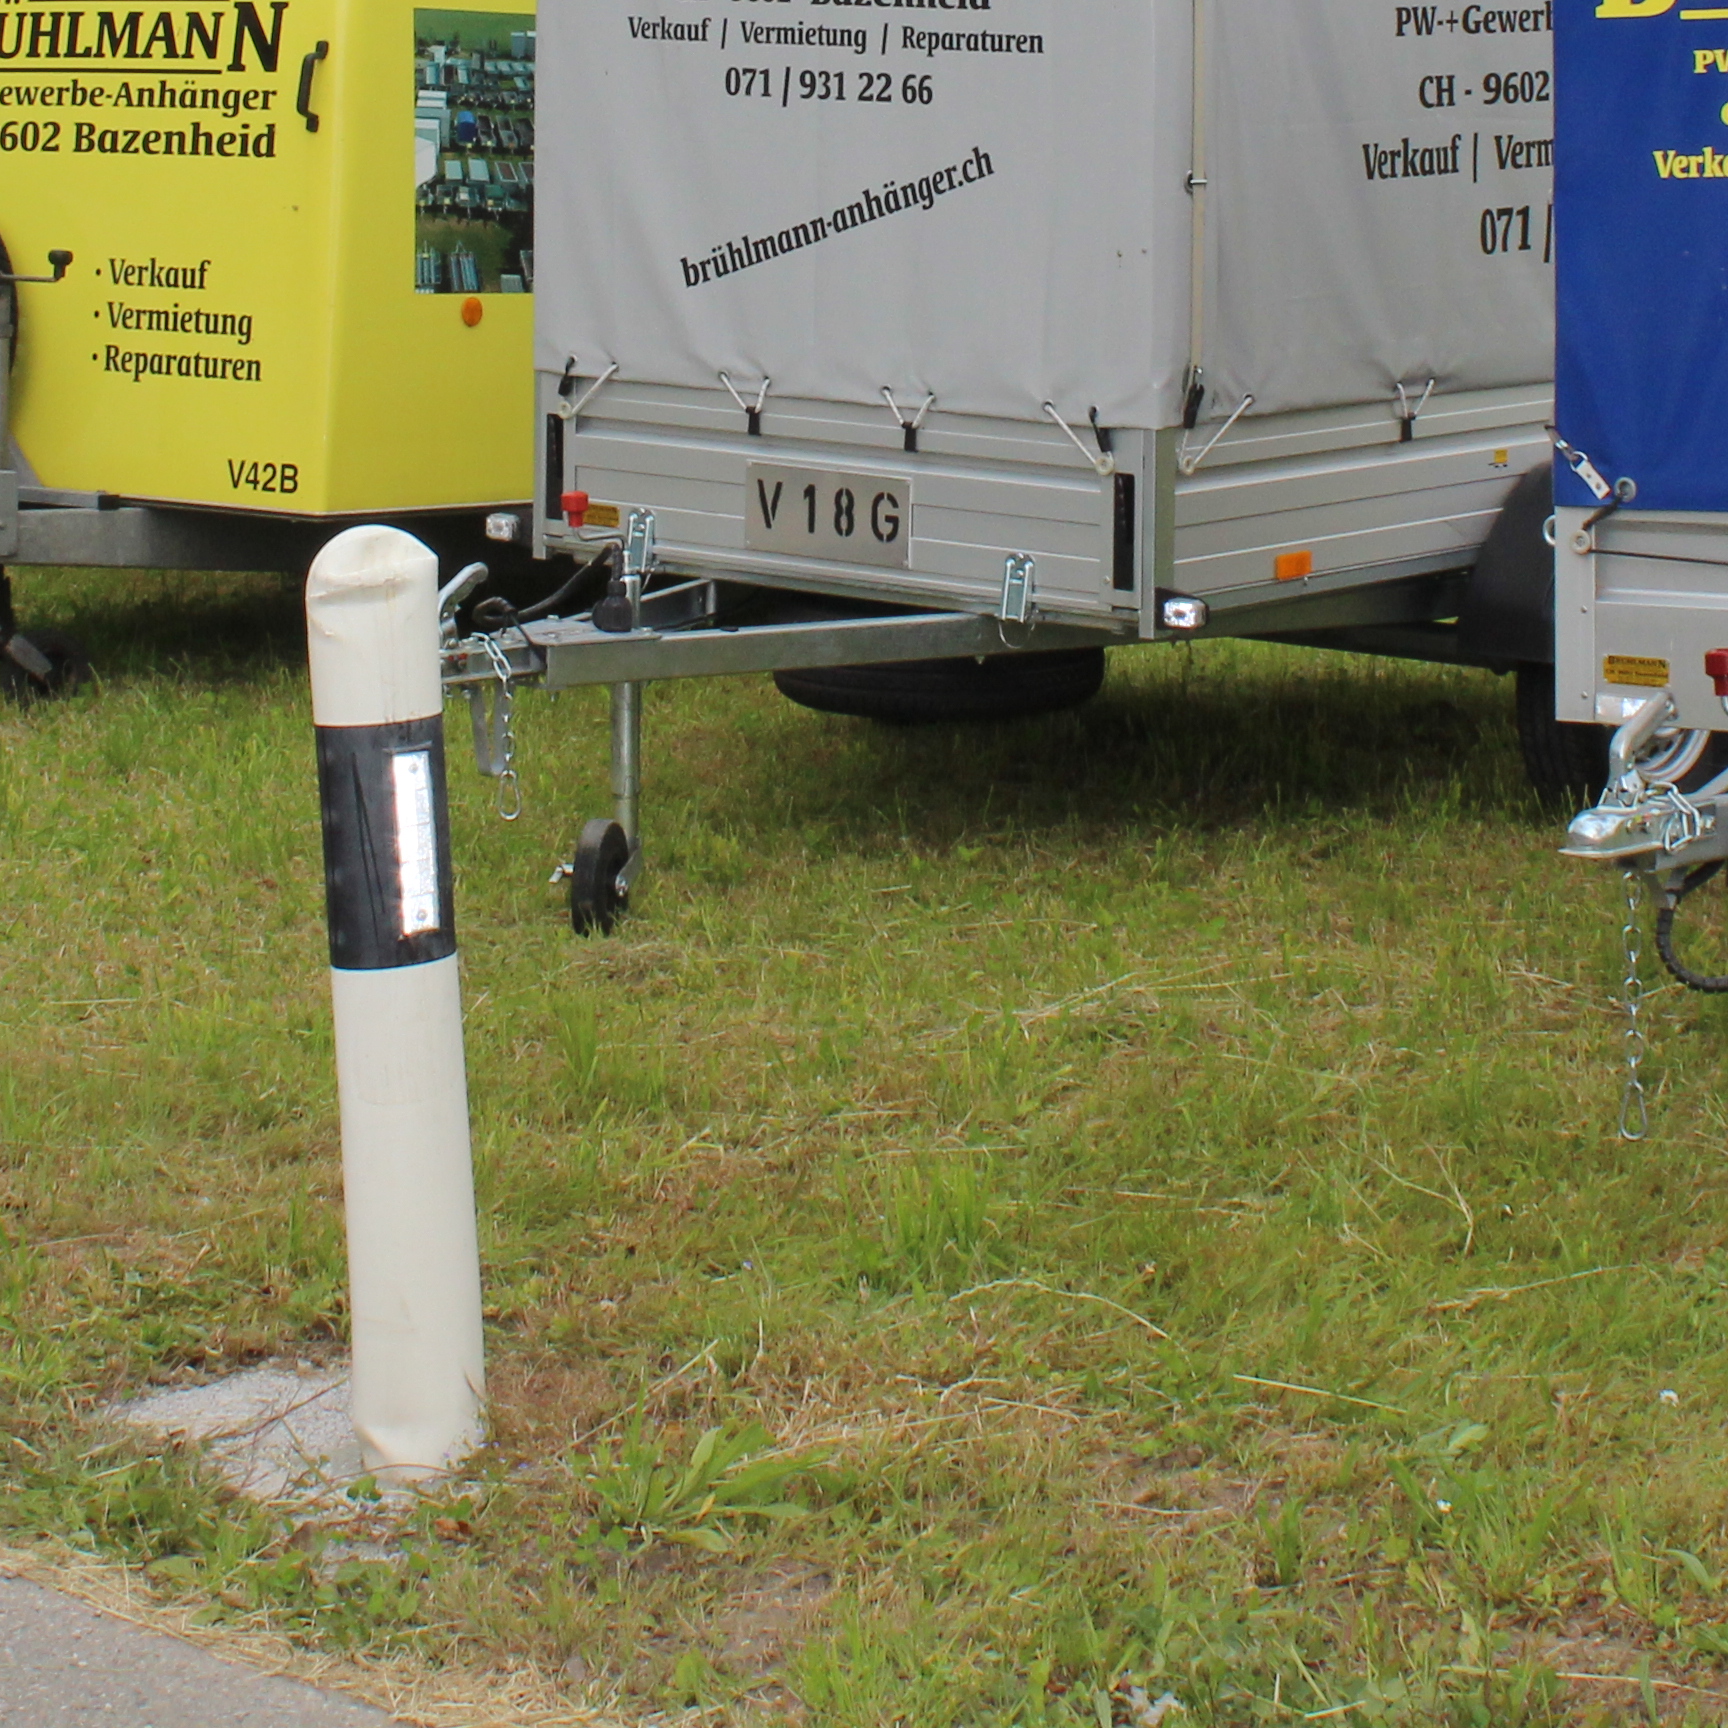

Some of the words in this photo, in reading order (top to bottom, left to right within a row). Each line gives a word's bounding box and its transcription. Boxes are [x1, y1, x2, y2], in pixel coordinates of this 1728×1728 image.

[627, 16, 712, 43] Verkauf
[740, 20, 868, 55] Vermietung
[901, 25, 1045, 58] Reparaturen
[725, 66, 772, 97] 071
[799, 68, 847, 101] 931
[858, 71, 892, 104] 22
[901, 73, 934, 105] 66
[1418, 75, 1455, 109] CH
[1482, 70, 1549, 105] 9602
[73, 123, 277, 158] Bazenheid
[1362, 134, 1461, 180] Verkauf
[680, 145, 996, 289] brühlmann-anhänger.ch
[1480, 204, 1531, 255] 071
[109, 258, 212, 290] Verkauf
[107, 301, 253, 345] Vermietung
[104, 344, 261, 383] Reparaturen
[228, 459, 299, 494] V42B
